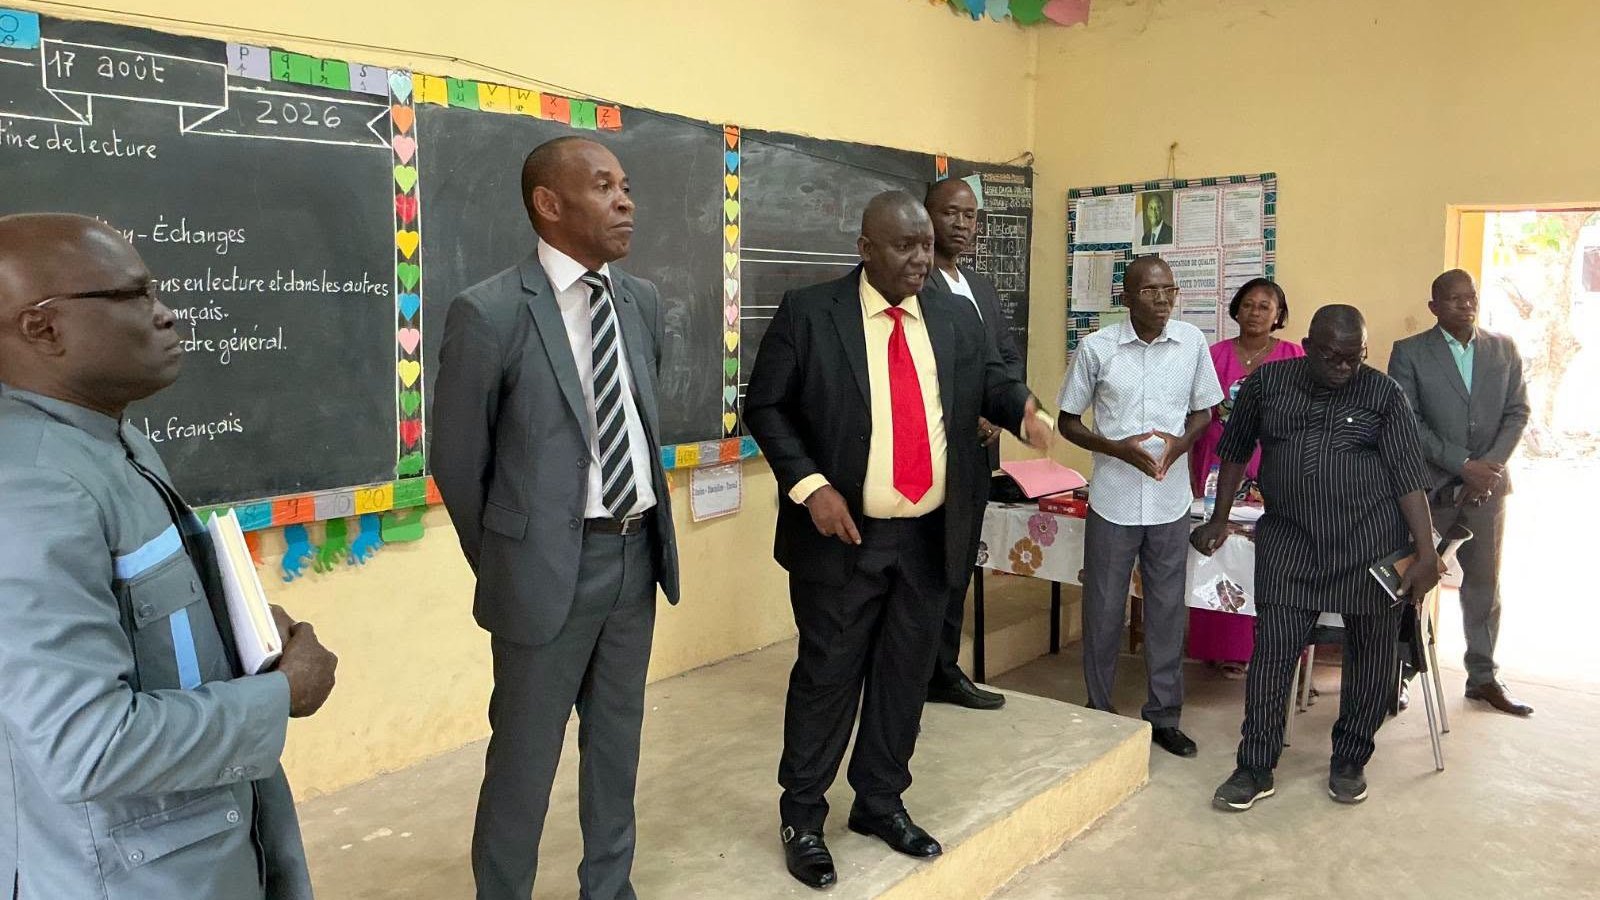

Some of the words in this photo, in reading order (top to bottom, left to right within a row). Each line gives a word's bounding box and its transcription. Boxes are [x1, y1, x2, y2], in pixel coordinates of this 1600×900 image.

[47, 50, 76, 78] 17
[97, 55, 164, 83] août
[255, 100, 341, 128] 2026
[206, 266, 265, 292] lecture
[283, 269, 320, 292] dans
[343, 271, 389, 297] autres
[172, 299, 229, 327] ançais.
[180, 327, 215, 352] dre
[219, 324, 288, 365] général.
[166, 411, 244, 441] français
